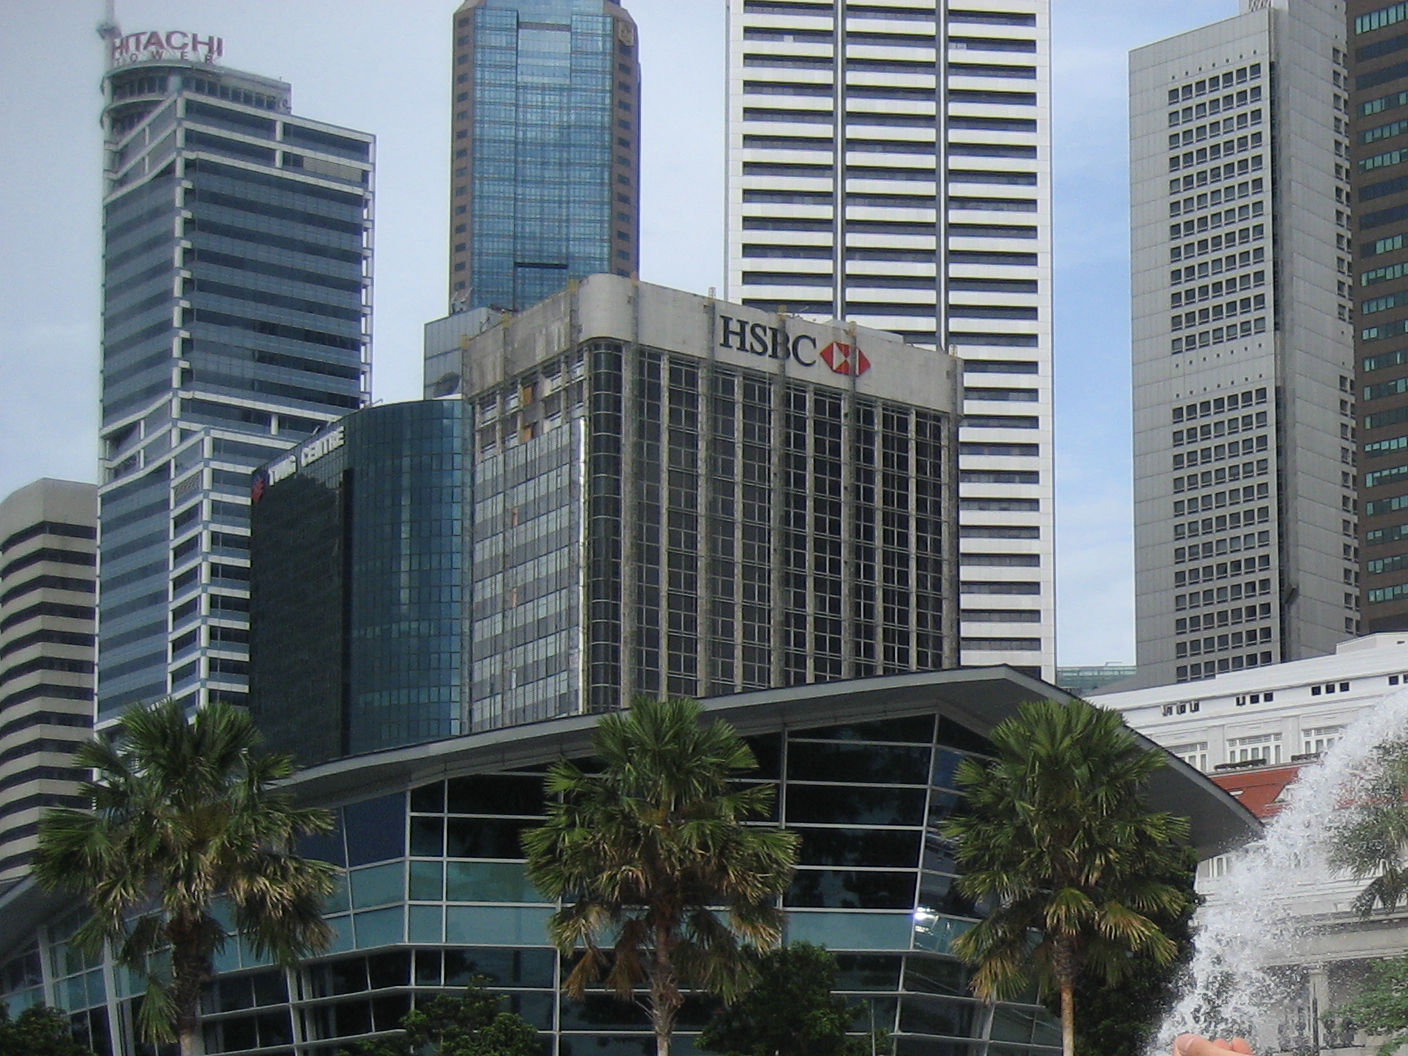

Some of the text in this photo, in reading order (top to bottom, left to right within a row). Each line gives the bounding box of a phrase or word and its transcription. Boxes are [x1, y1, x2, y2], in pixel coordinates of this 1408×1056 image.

[112, 31, 223, 57] HITACHI
[114, 50, 214, 66] TOWER
[719, 315, 817, 367] HSBC
